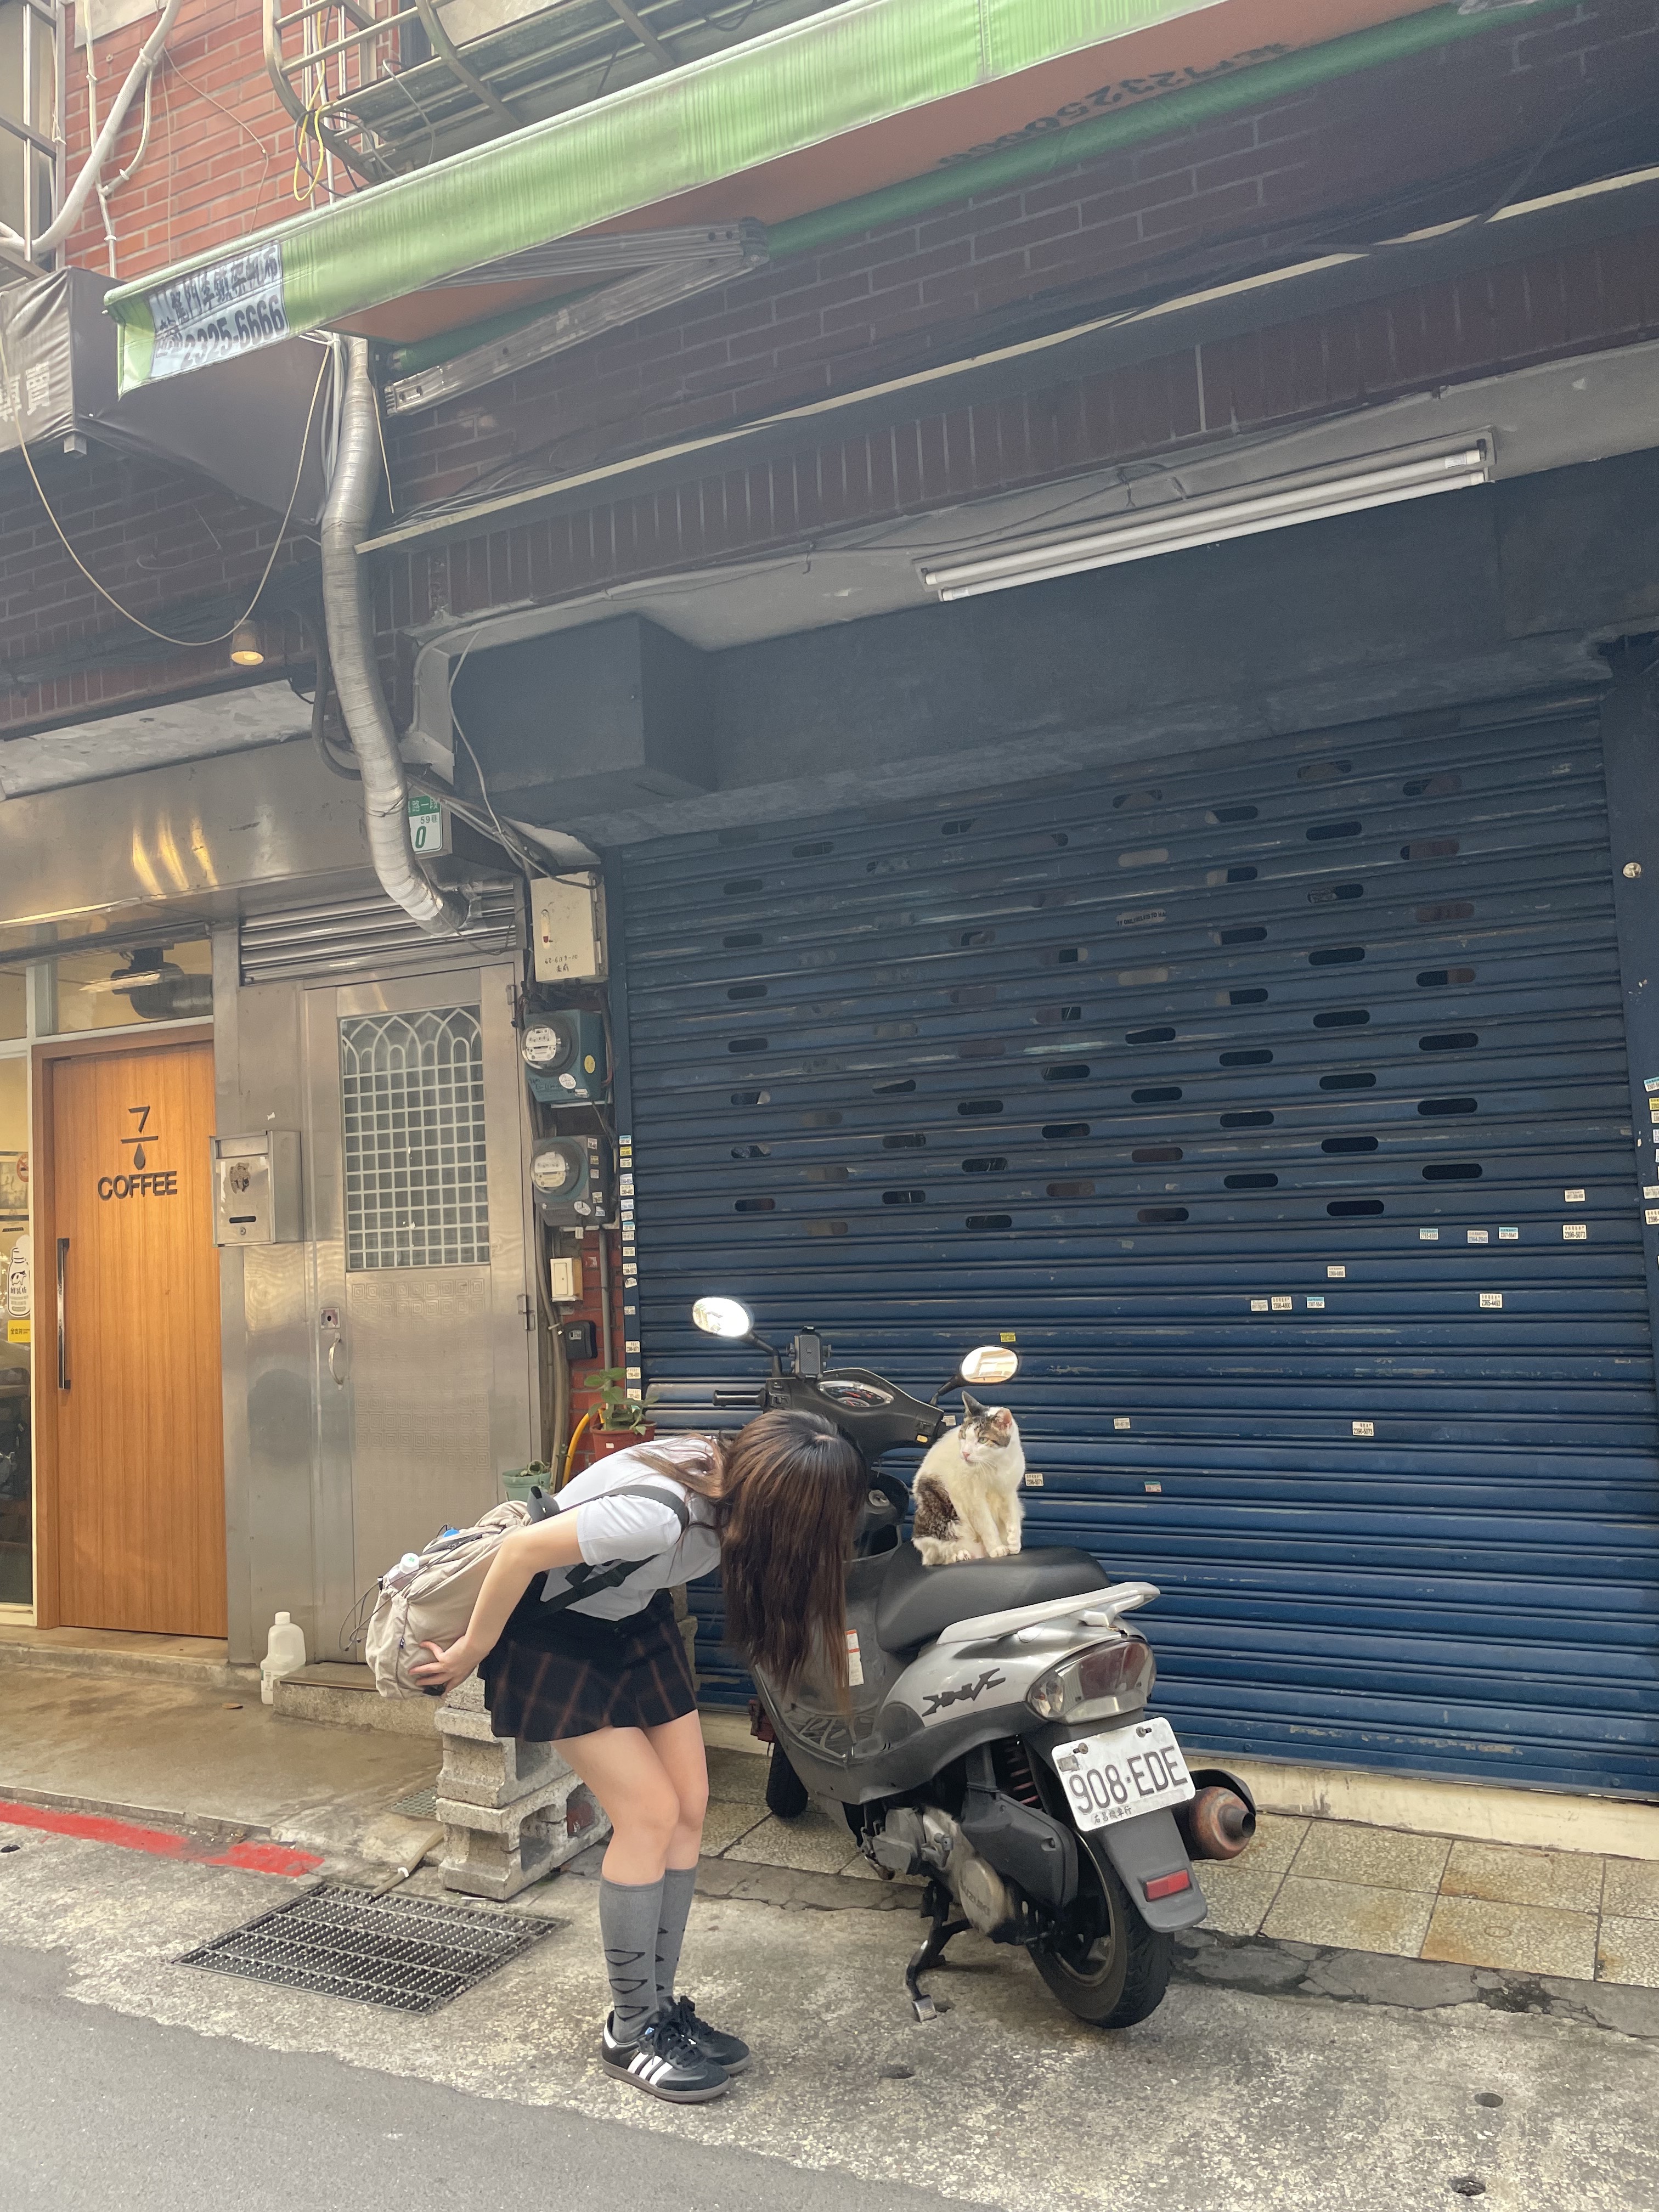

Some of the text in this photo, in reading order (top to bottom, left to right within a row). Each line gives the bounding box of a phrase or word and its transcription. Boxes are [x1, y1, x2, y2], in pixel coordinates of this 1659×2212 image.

[181, 295, 285, 369] 2325-6666
[128, 1104, 150, 1133] 7
[98, 1171, 177, 1201] COFFEE
